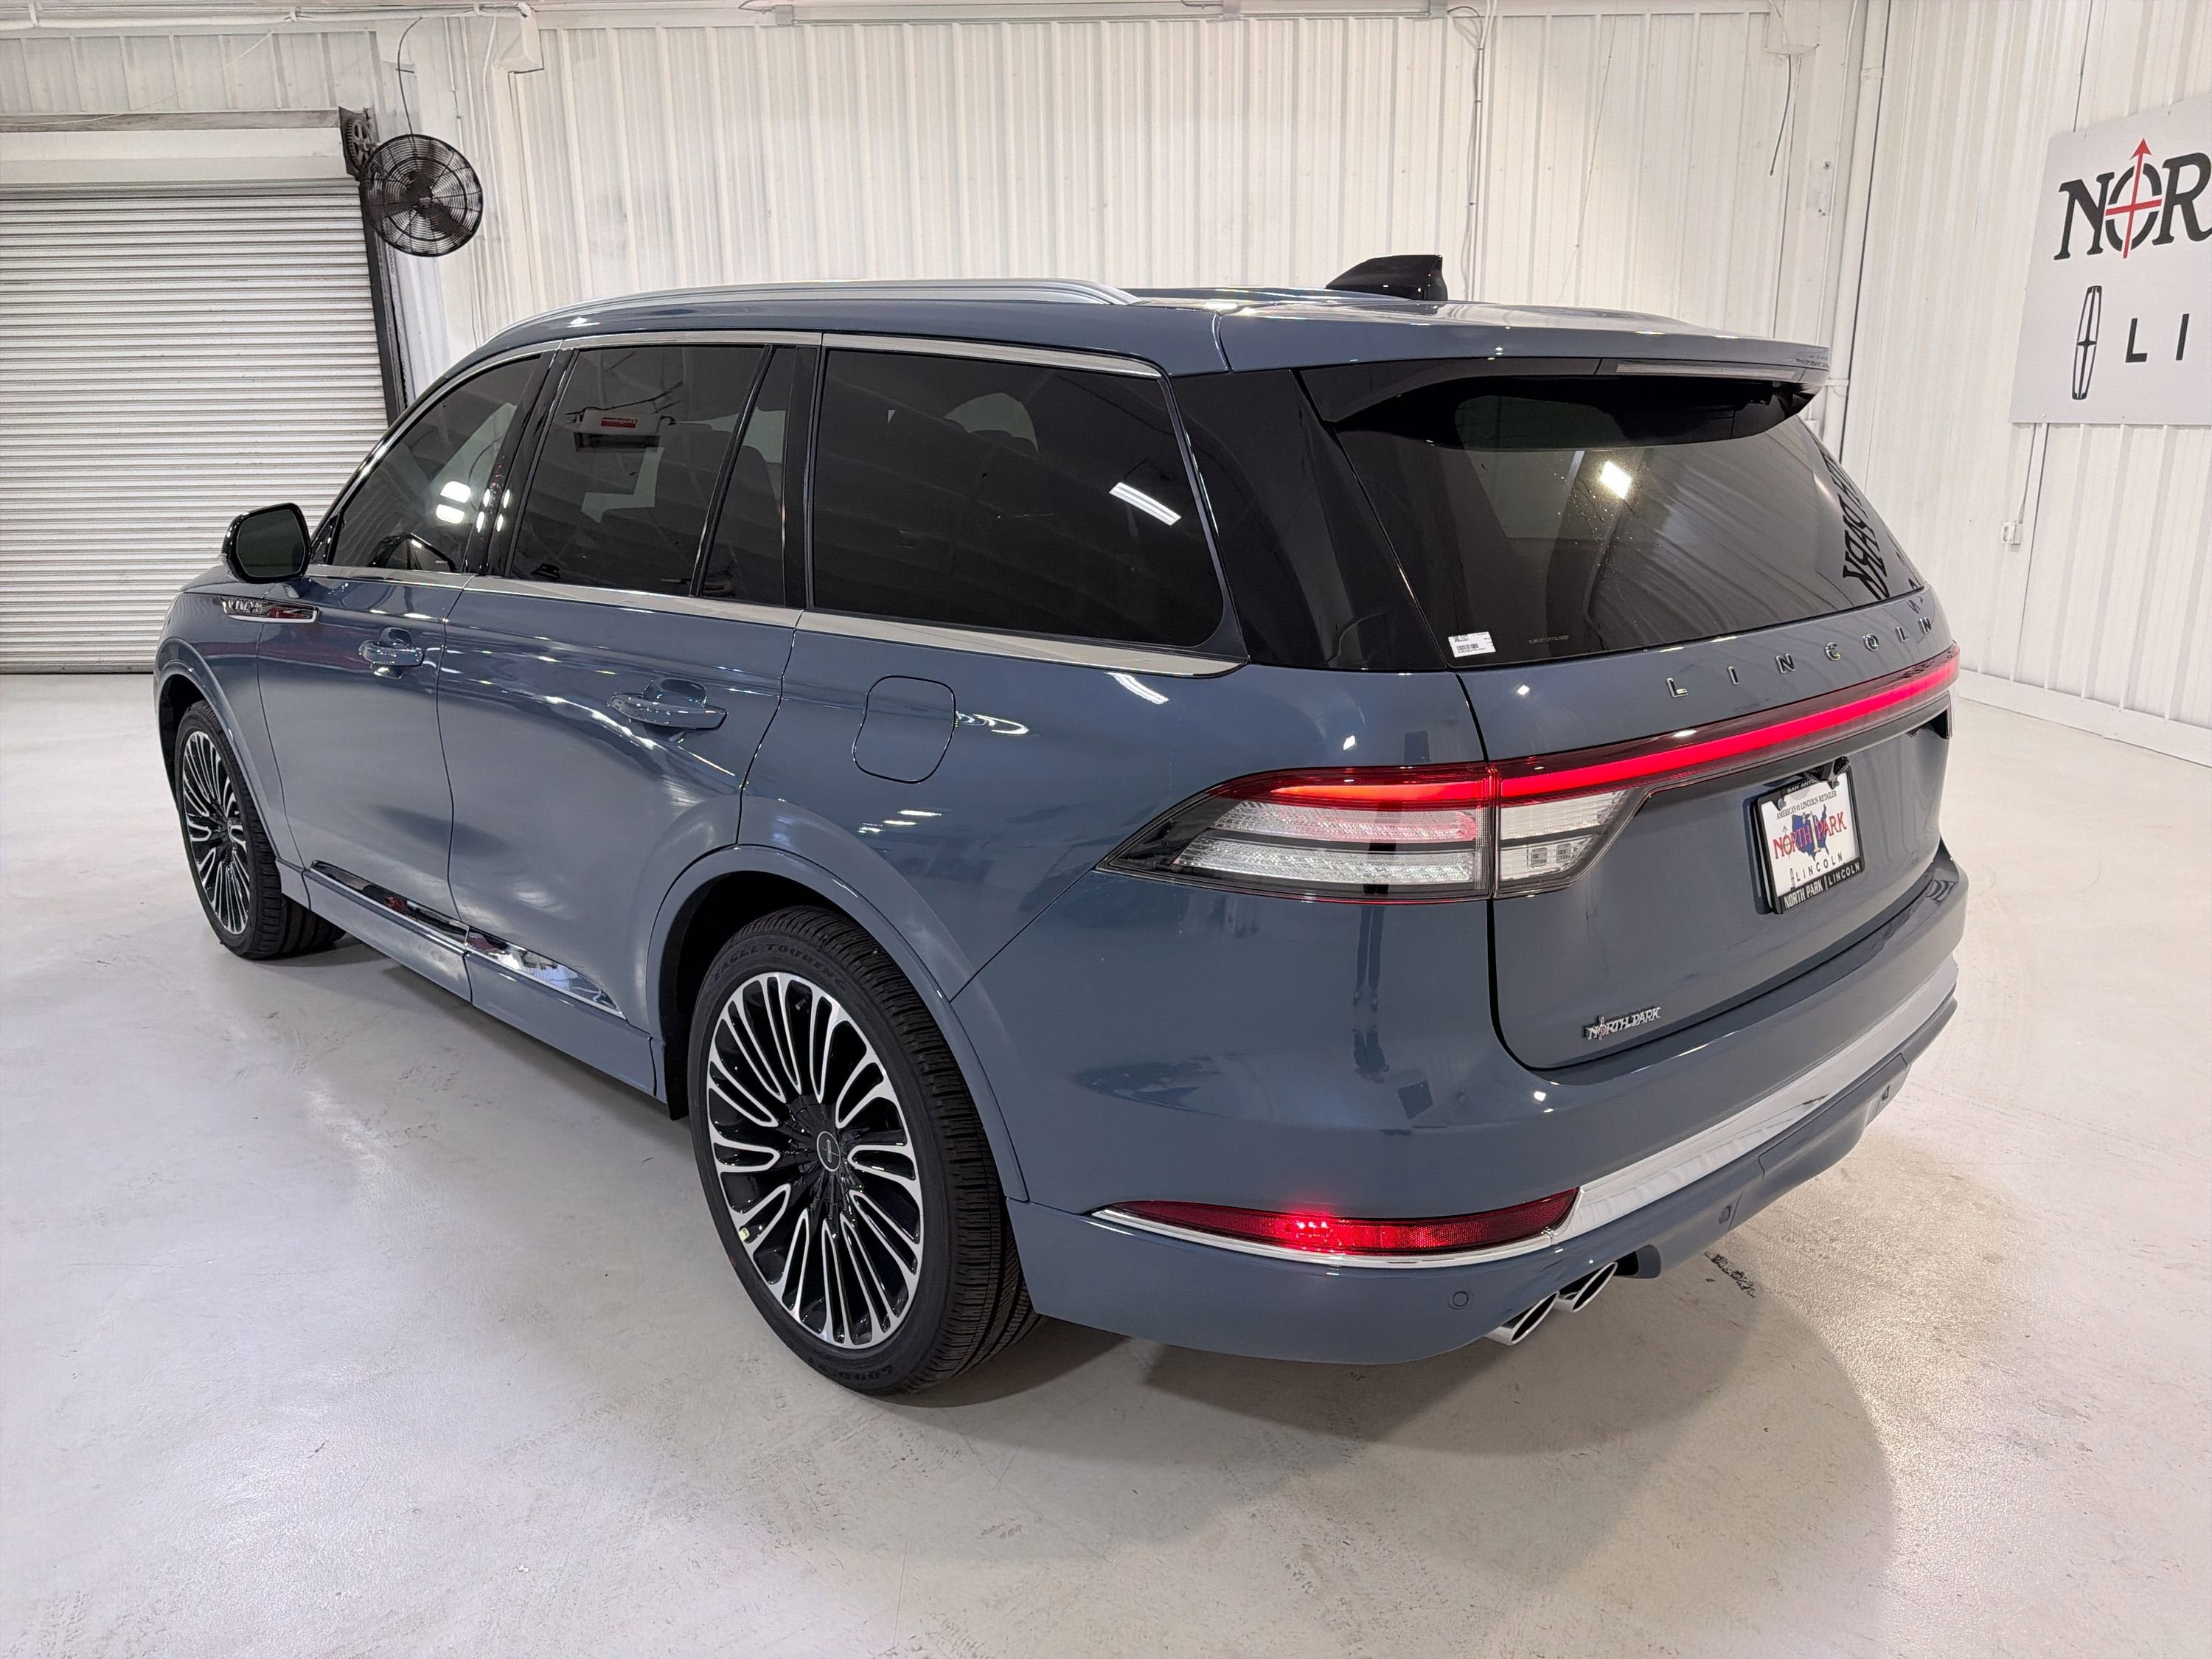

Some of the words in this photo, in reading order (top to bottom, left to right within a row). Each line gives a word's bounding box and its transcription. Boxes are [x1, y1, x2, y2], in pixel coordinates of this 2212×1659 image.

[1666, 616, 1933, 698] LINCOLN
[1787, 785, 1800, 793] SAN
[1801, 797, 1819, 810] LINCOLN
[1818, 790, 1837, 803] RETAILER
[1773, 824, 1812, 859] NORTH
[1817, 811, 1848, 841] PARK
[1795, 852, 1843, 882] LINCOLN
[1784, 887, 1806, 910] NORTH
[1805, 879, 1823, 899] PARK
[1829, 861, 1860, 885] LINCOLN
[1585, 1016, 1632, 1040] NORTH
[1631, 1006, 1661, 1027] PARK
